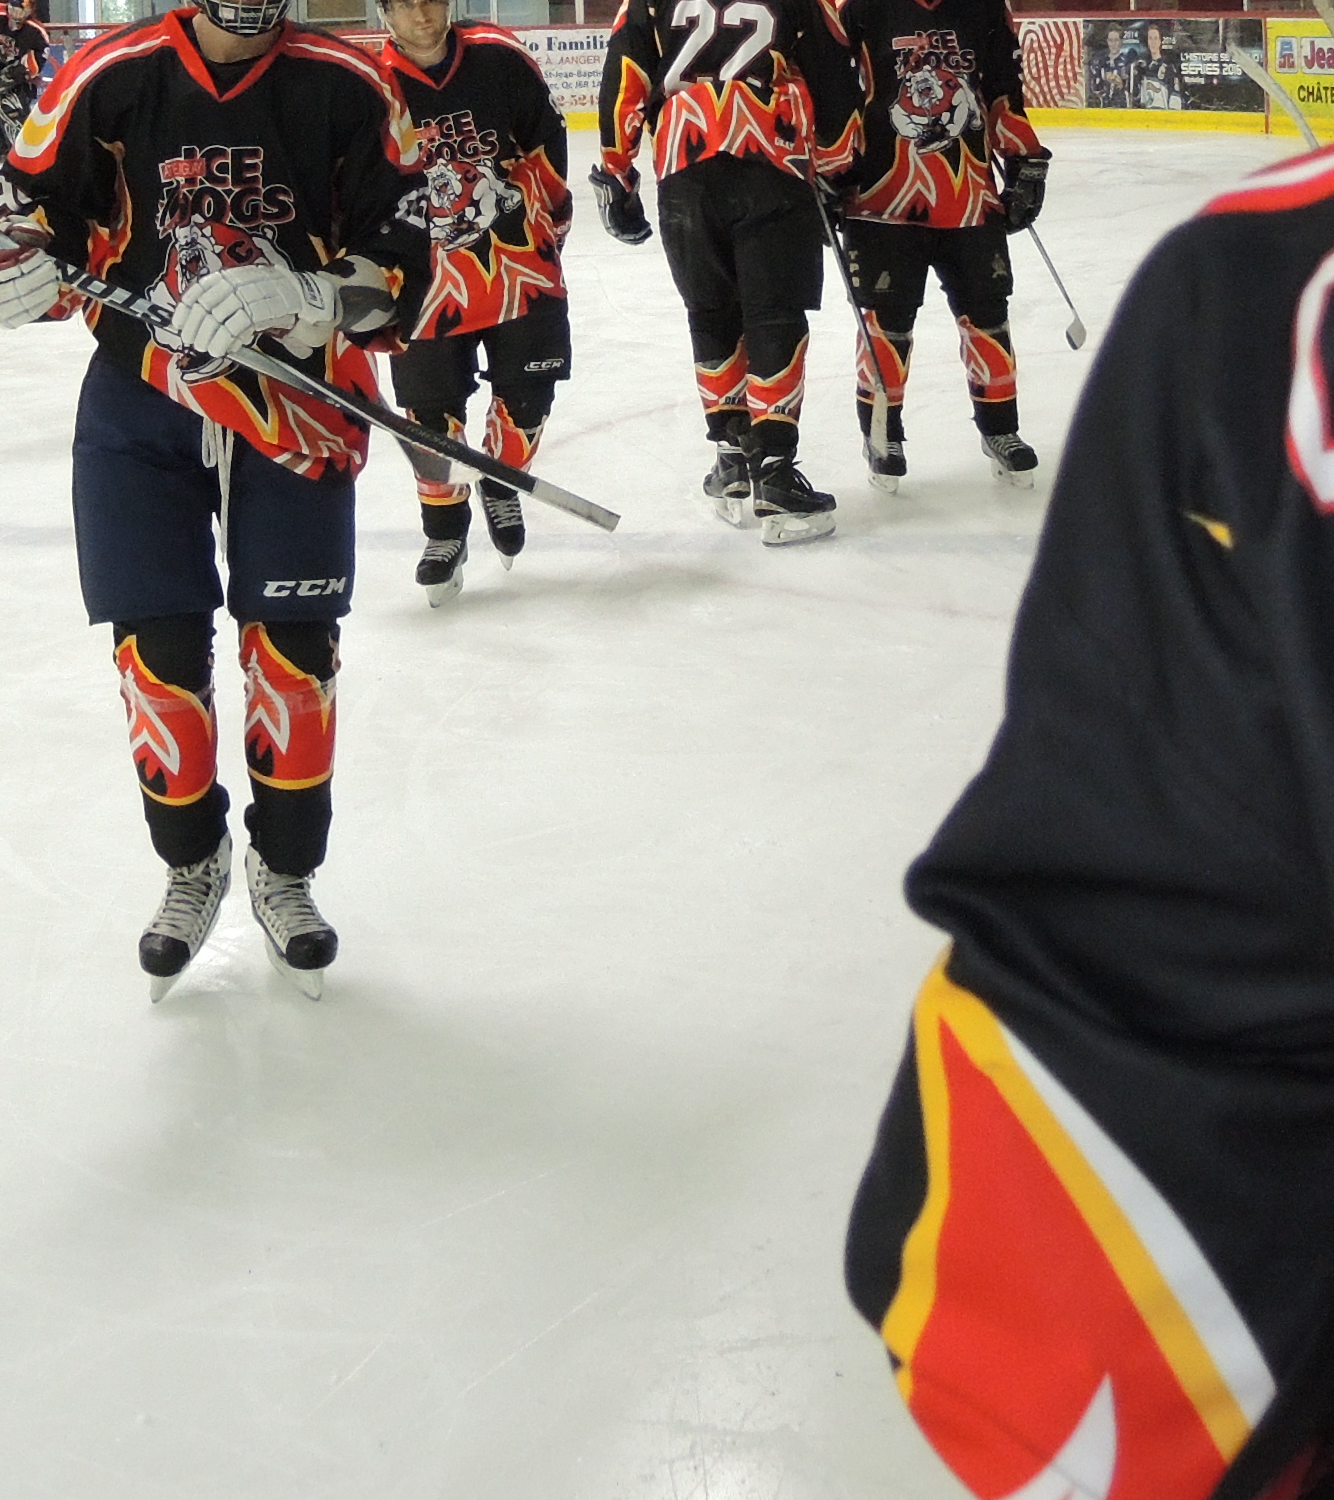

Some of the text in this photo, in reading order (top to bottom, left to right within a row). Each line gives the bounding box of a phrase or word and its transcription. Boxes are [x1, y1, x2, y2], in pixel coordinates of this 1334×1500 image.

[547, 35, 609, 51] Famili
[181, 145, 263, 190] ICE
[263, 577, 346, 597] CCM
